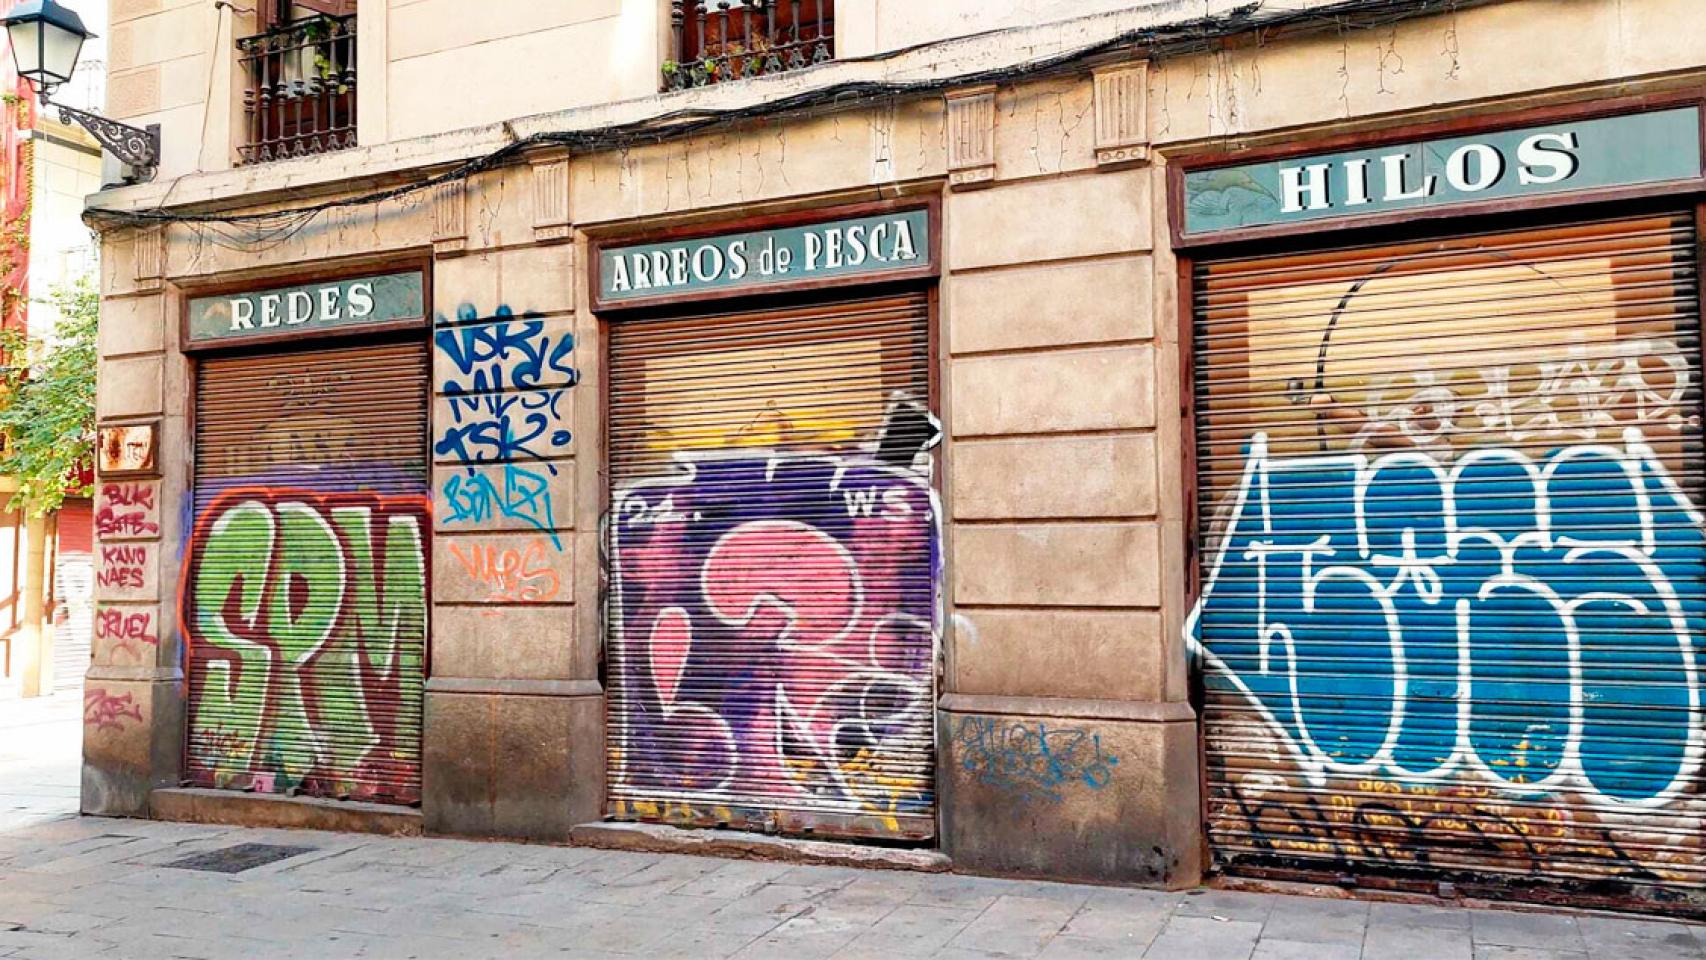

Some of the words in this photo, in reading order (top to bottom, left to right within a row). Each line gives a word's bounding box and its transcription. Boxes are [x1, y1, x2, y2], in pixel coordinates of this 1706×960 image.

[1279, 132, 1579, 213] HILOS
[611, 240, 748, 292] ARREOS
[760, 237, 792, 275] de
[804, 220, 919, 271] PESCA
[229, 282, 375, 331] REDES
